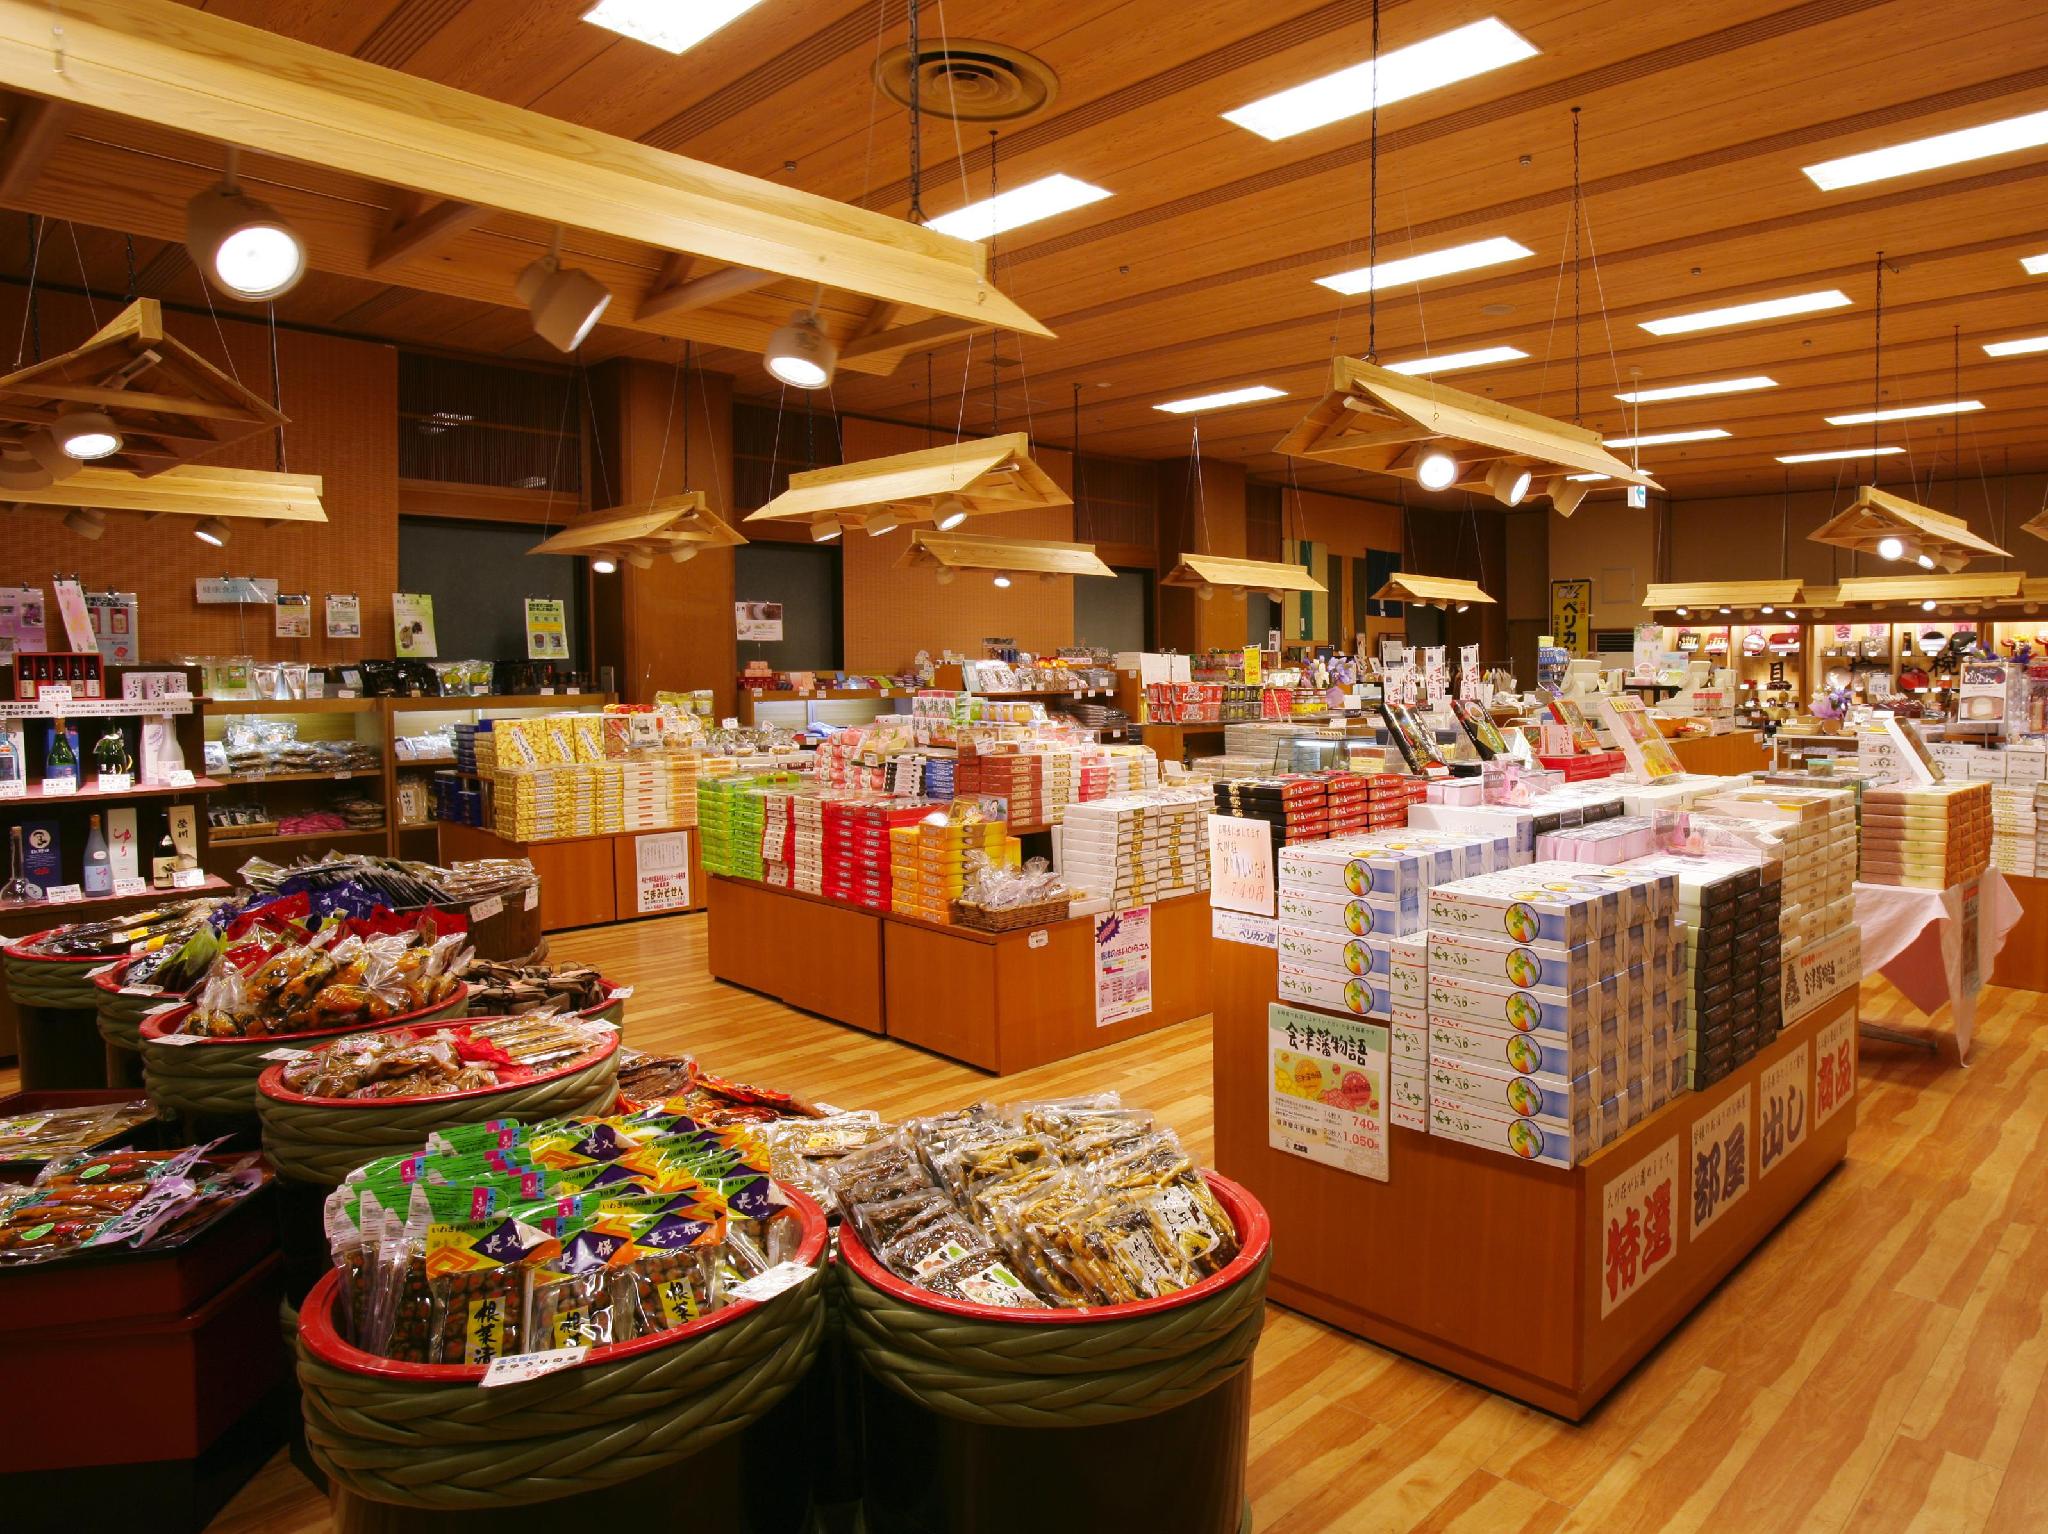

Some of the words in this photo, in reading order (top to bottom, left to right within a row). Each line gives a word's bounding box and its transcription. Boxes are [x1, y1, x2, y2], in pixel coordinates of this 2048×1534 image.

[643, 886, 684, 900] ごまみそせん
[1240, 928, 1276, 944] ペリカン便
[1285, 1021, 1368, 1067] 会津藩物語
[1818, 1038, 1852, 1119] 商品
[1352, 1115, 1380, 1133] 740円
[1762, 1084, 1804, 1169] 出し
[1694, 1122, 1745, 1226] 部屋
[649, 1225, 702, 1246] 長久保
[1606, 1177, 1672, 1303] 特選
[559, 1240, 614, 1270] 長保
